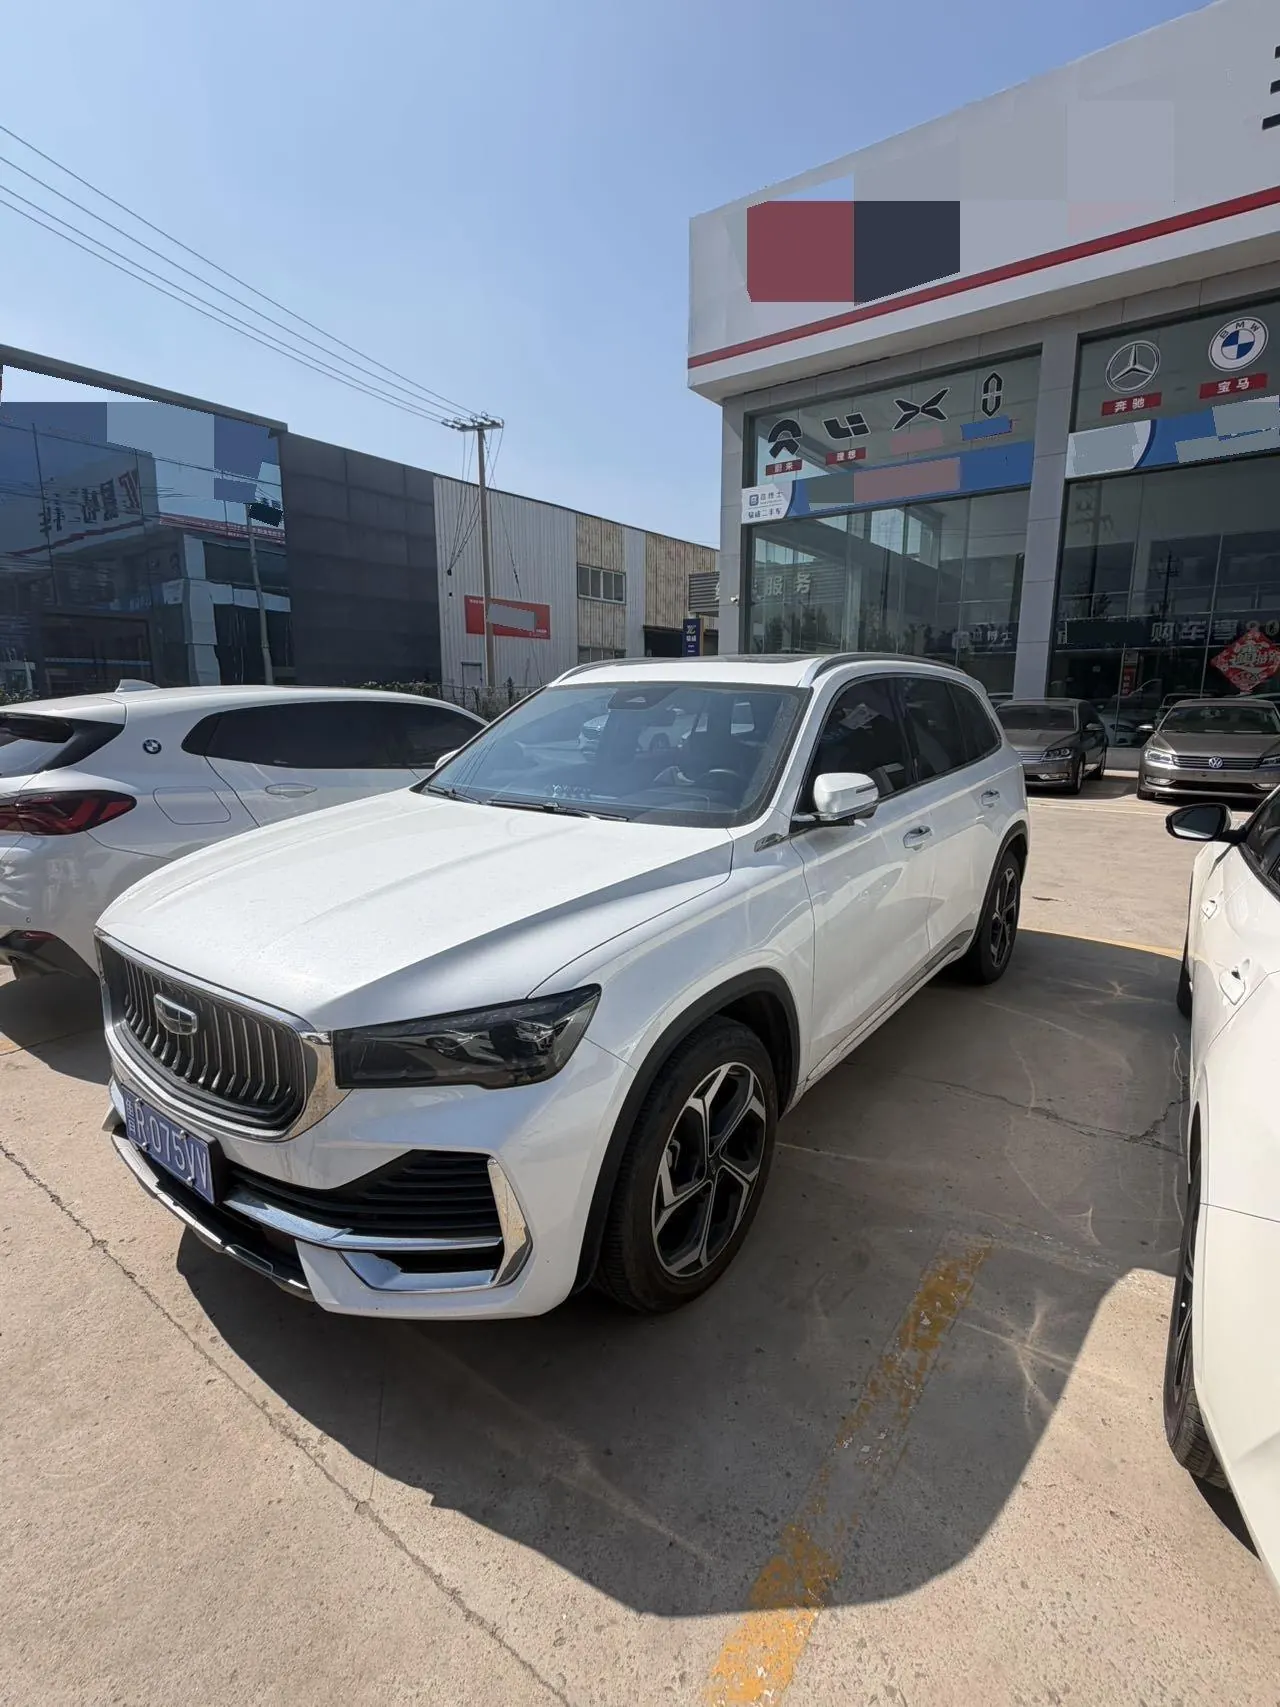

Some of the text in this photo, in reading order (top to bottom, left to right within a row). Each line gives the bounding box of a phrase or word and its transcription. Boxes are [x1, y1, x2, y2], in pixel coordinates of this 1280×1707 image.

[1219, 321, 1260, 340] BMW
[1217, 377, 1250, 394] 宝马
[1114, 396, 1145, 413] 奔驰
[836, 449, 857, 461] 理想
[774, 461, 793, 473] 蔚来
